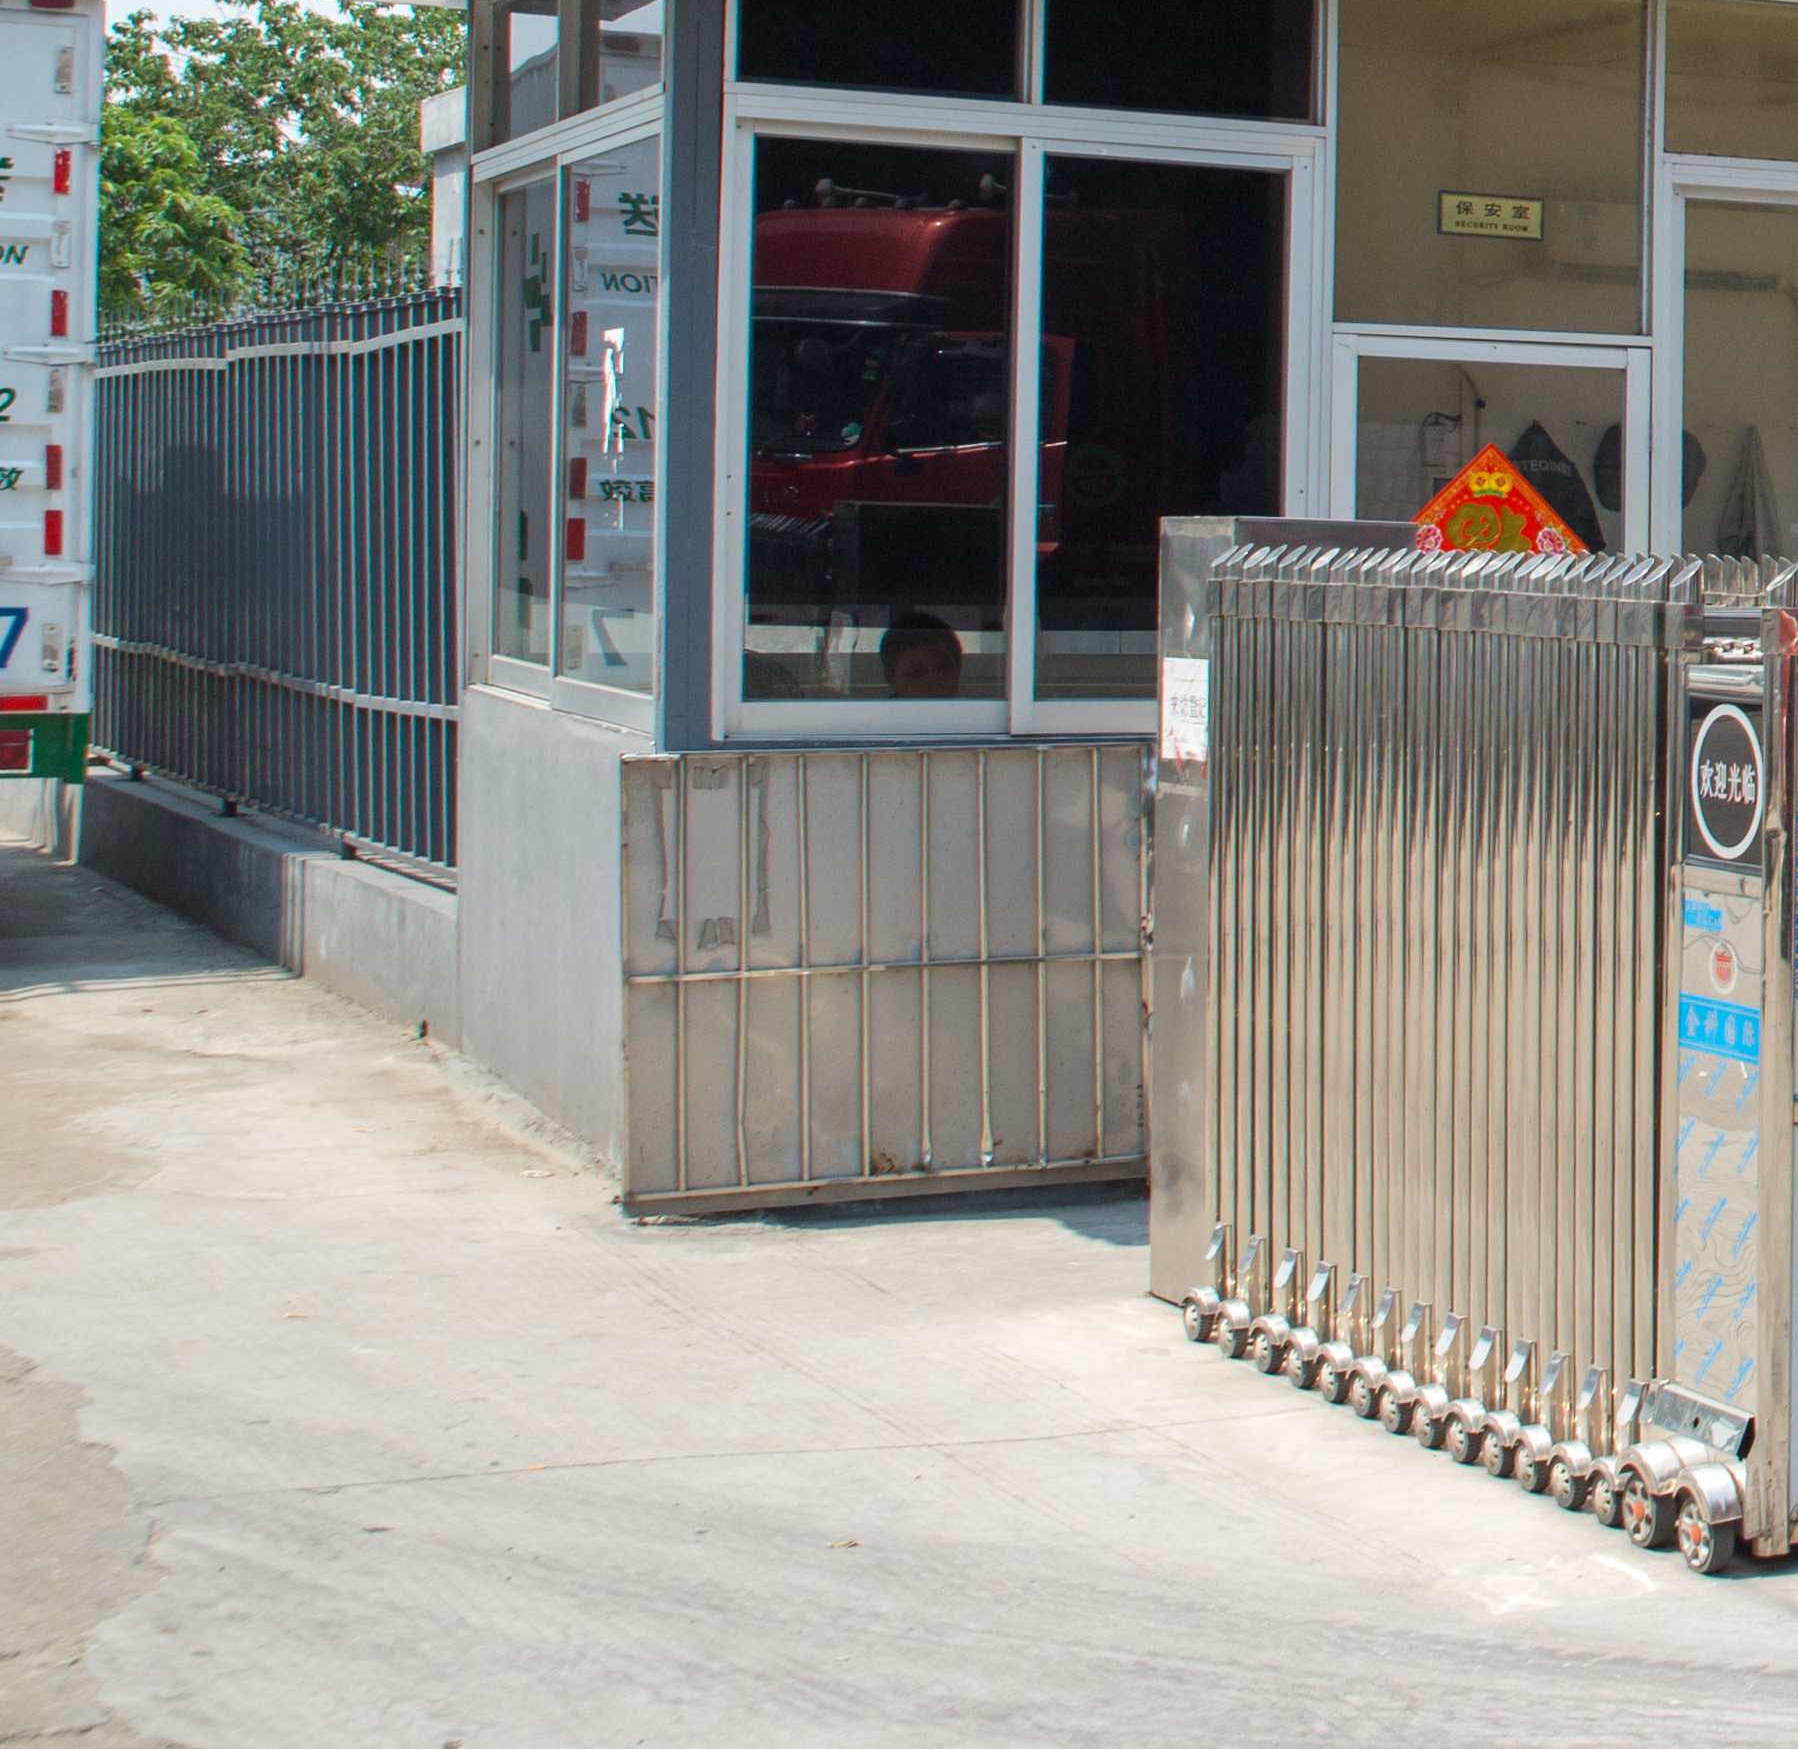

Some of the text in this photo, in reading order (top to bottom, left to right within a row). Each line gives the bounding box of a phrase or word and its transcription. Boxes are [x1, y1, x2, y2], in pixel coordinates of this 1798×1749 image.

[1456, 201, 1530, 219] 保安室
[1455, 220, 1499, 230] SECURITY
[0, 245, 29, 264] N
[1700, 759, 1756, 804] 欢迎光临
